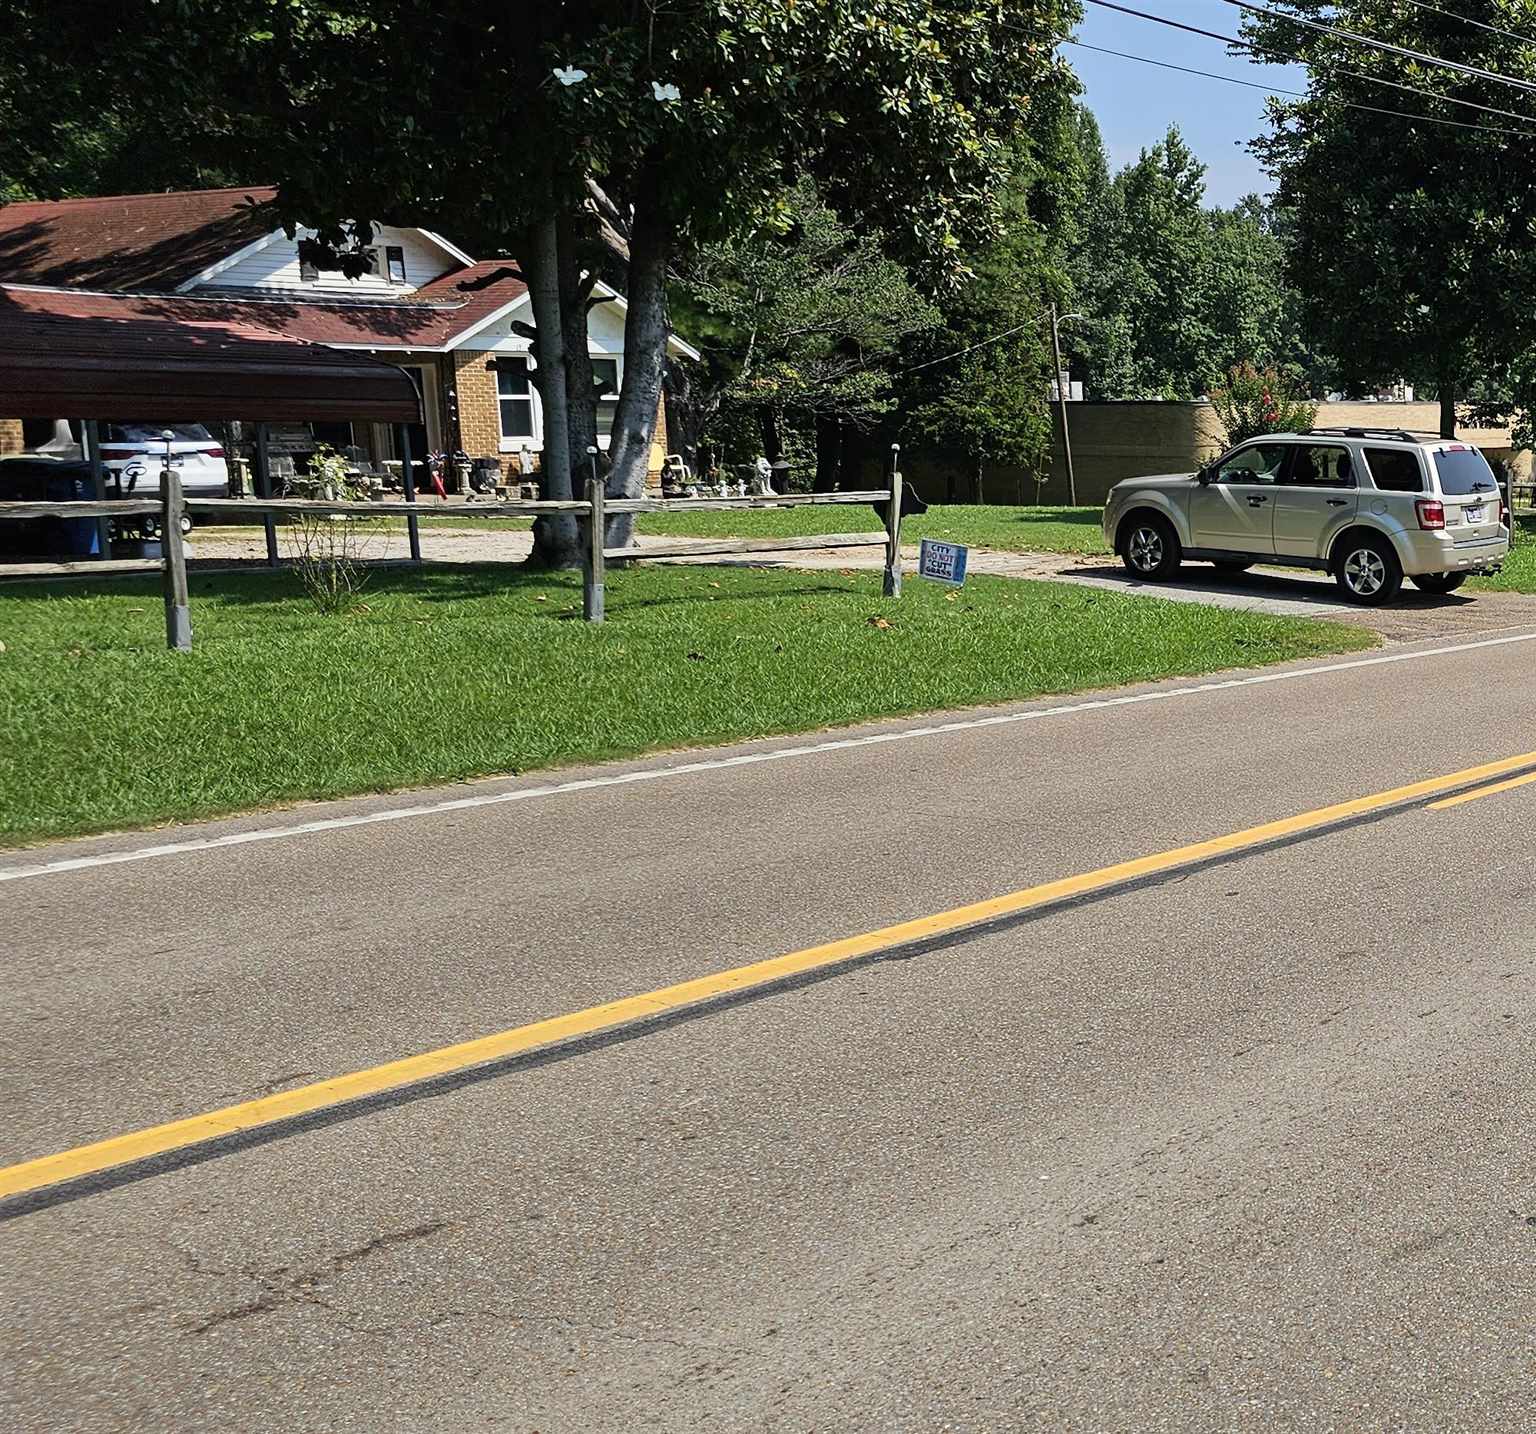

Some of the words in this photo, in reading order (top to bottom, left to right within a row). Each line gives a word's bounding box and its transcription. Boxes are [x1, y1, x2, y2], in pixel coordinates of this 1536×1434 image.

[931, 544, 950, 554] CITY
[927, 551, 937, 560] DO
[938, 553, 953, 563] NOT
[925, 566, 952, 577] GRASS
